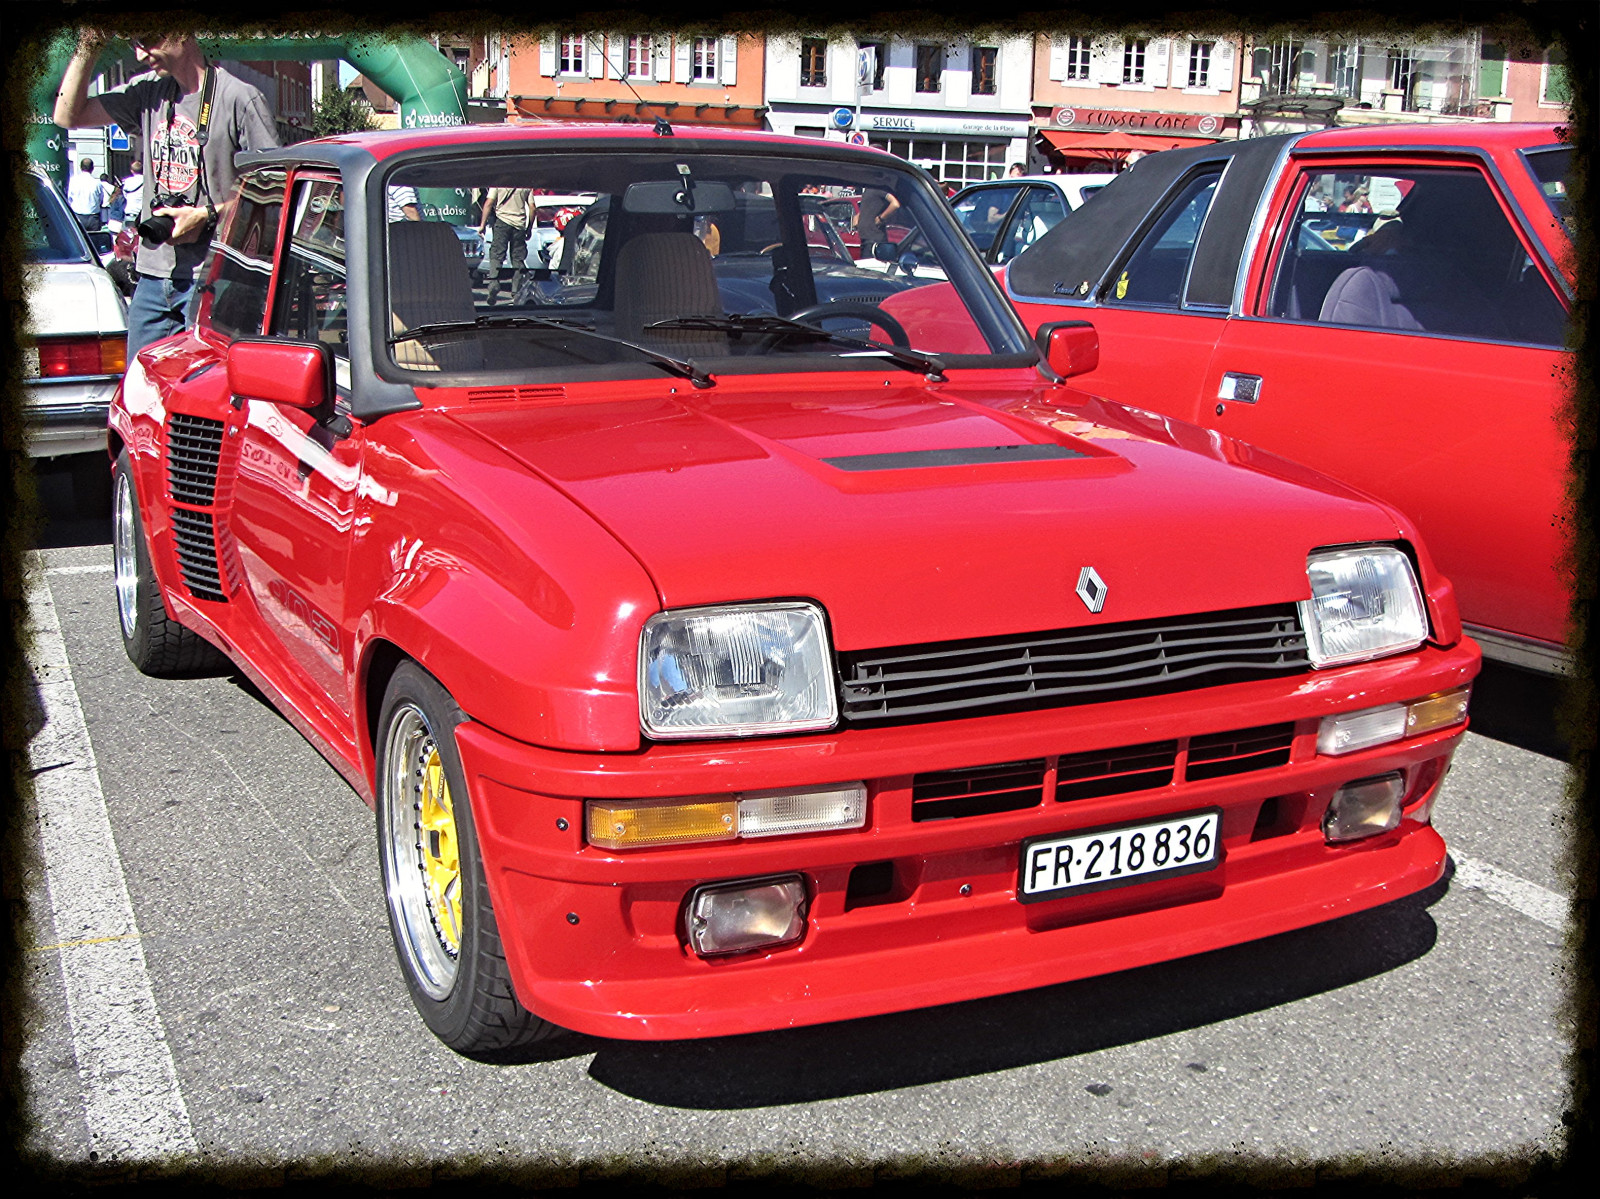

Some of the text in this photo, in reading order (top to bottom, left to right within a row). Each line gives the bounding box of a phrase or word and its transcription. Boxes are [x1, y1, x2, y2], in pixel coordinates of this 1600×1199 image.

[200, 103, 210, 126] Nikon
[418, 112, 463, 126] vaudoise
[1086, 112, 1148, 127] SUNSET
[873, 116, 915, 128] SERVICE
[962, 123, 984, 131] Garage
